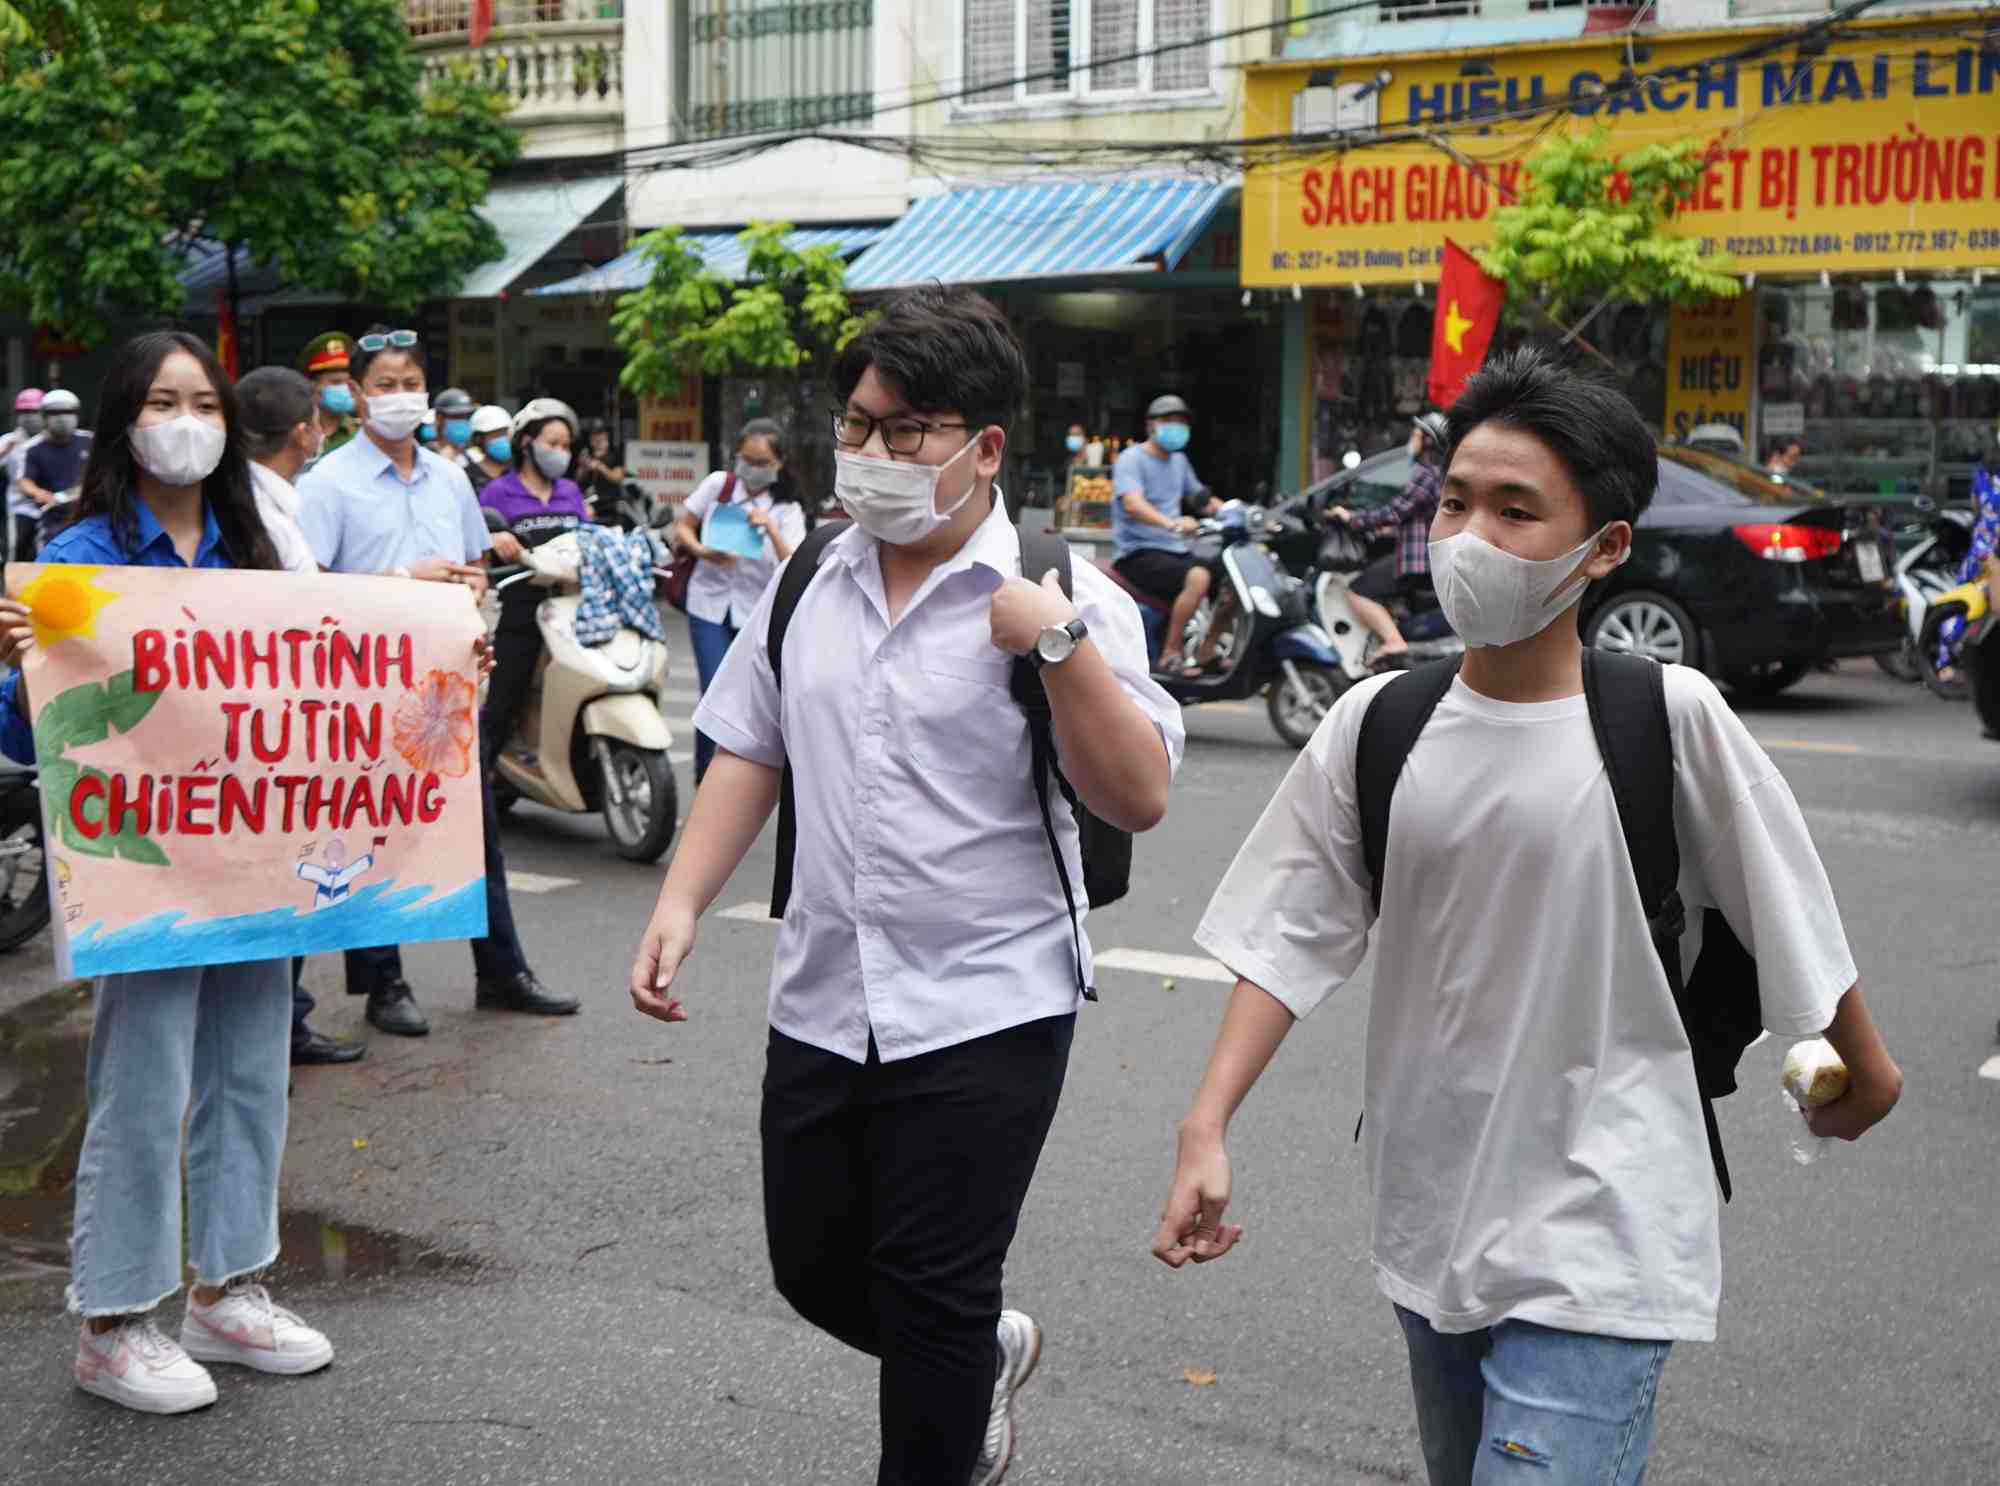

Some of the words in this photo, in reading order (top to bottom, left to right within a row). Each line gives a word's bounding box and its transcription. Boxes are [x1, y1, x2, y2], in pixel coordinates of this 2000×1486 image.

[1762, 54, 1888, 107] MAI
[1302, 158, 1395, 226] SÁCH
[1758, 145, 1800, 221] BỊ
[1810, 120, 1985, 208] TRƯỜNG
[1679, 348, 1742, 397] HIỆU
